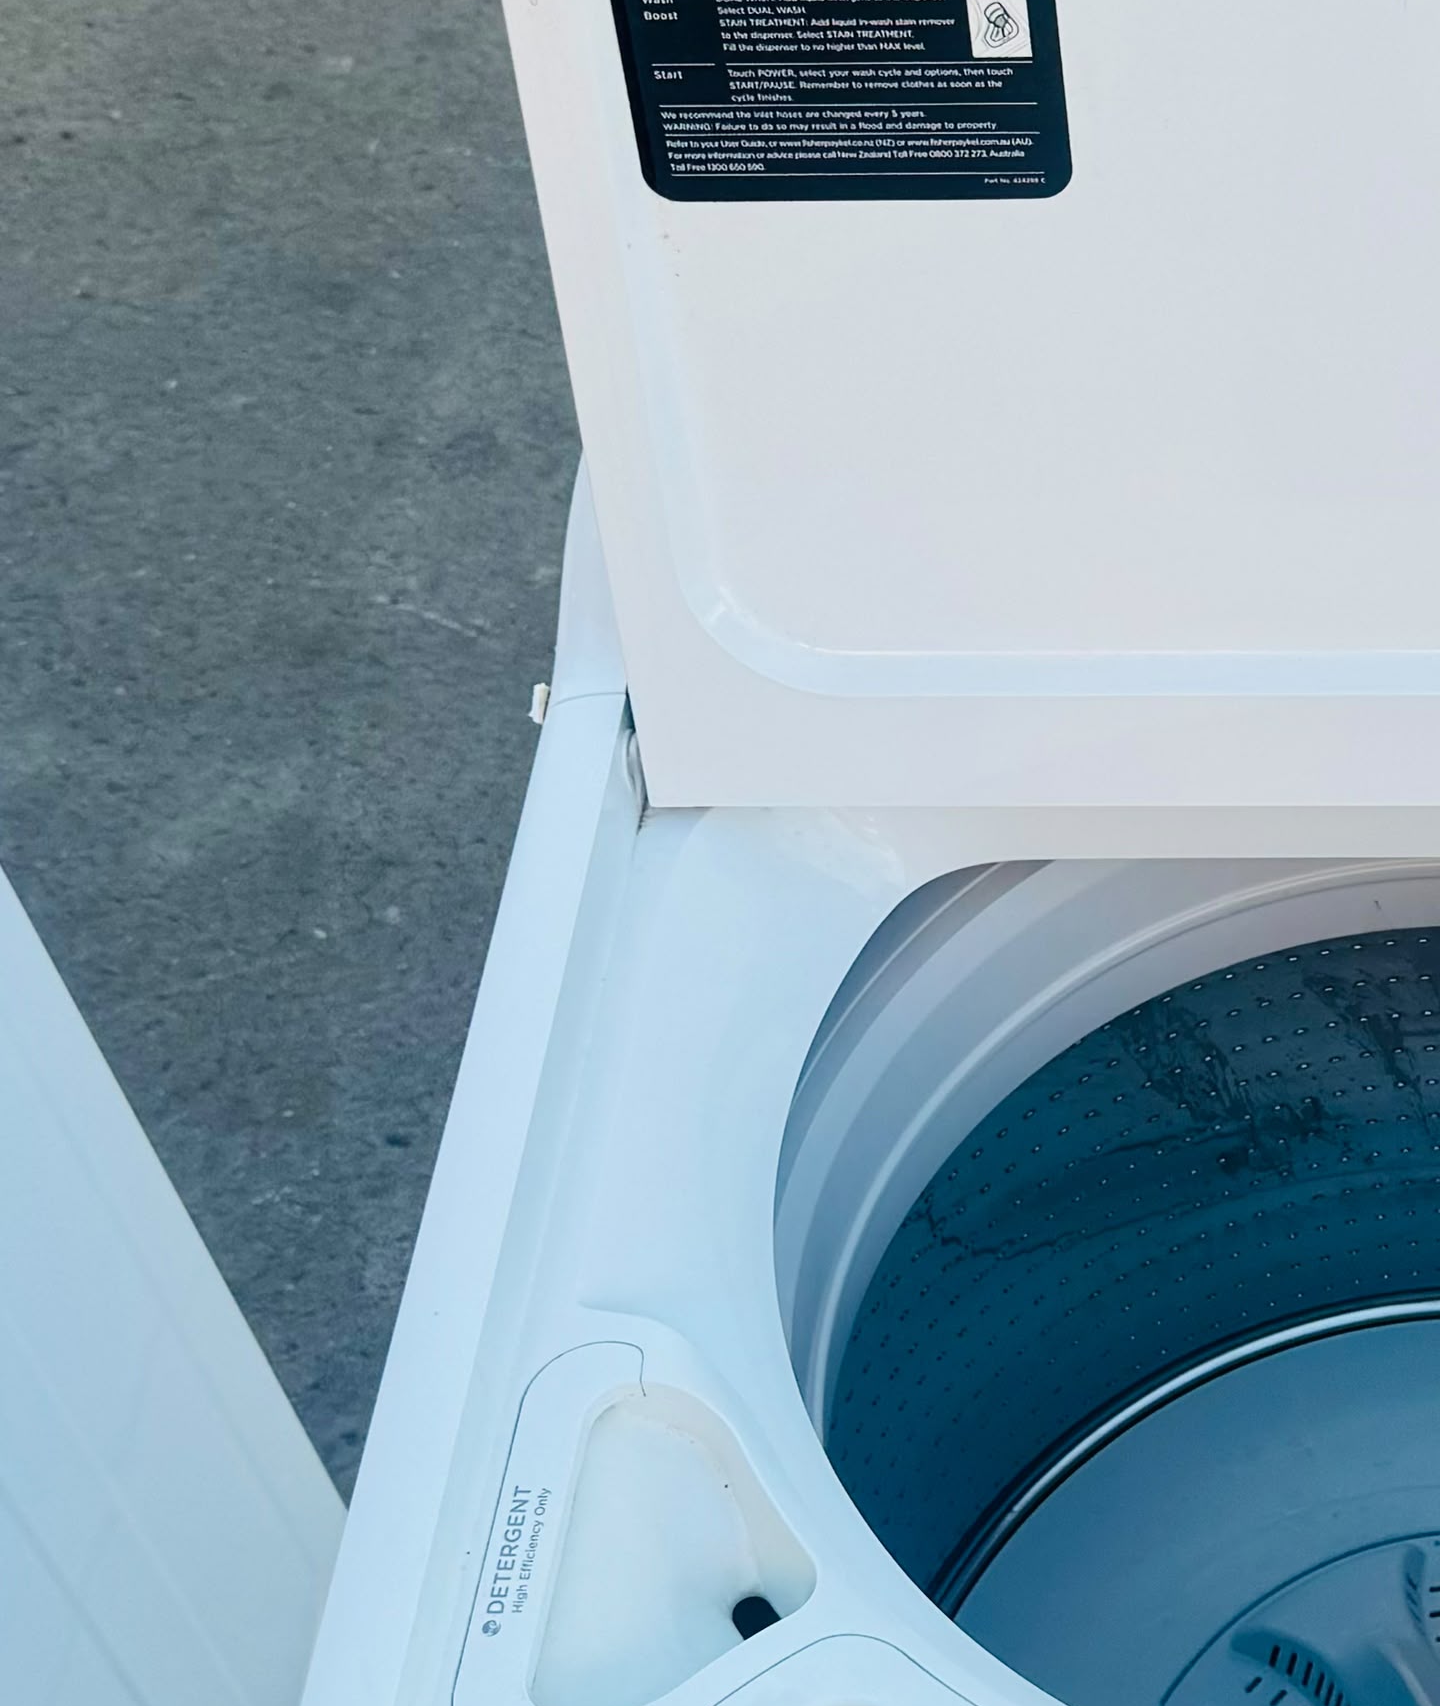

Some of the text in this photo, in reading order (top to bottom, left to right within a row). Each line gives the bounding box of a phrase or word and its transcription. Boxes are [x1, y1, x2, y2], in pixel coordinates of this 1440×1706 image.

[642, 10, 678, 20] Boost
[652, 70, 683, 79] Start
[985, 67, 1014, 76] touch
[986, 79, 1003, 87] the
[486, 1485, 532, 1614] DETERGENT
[511, 1488, 552, 1613] High Efficiency Only
